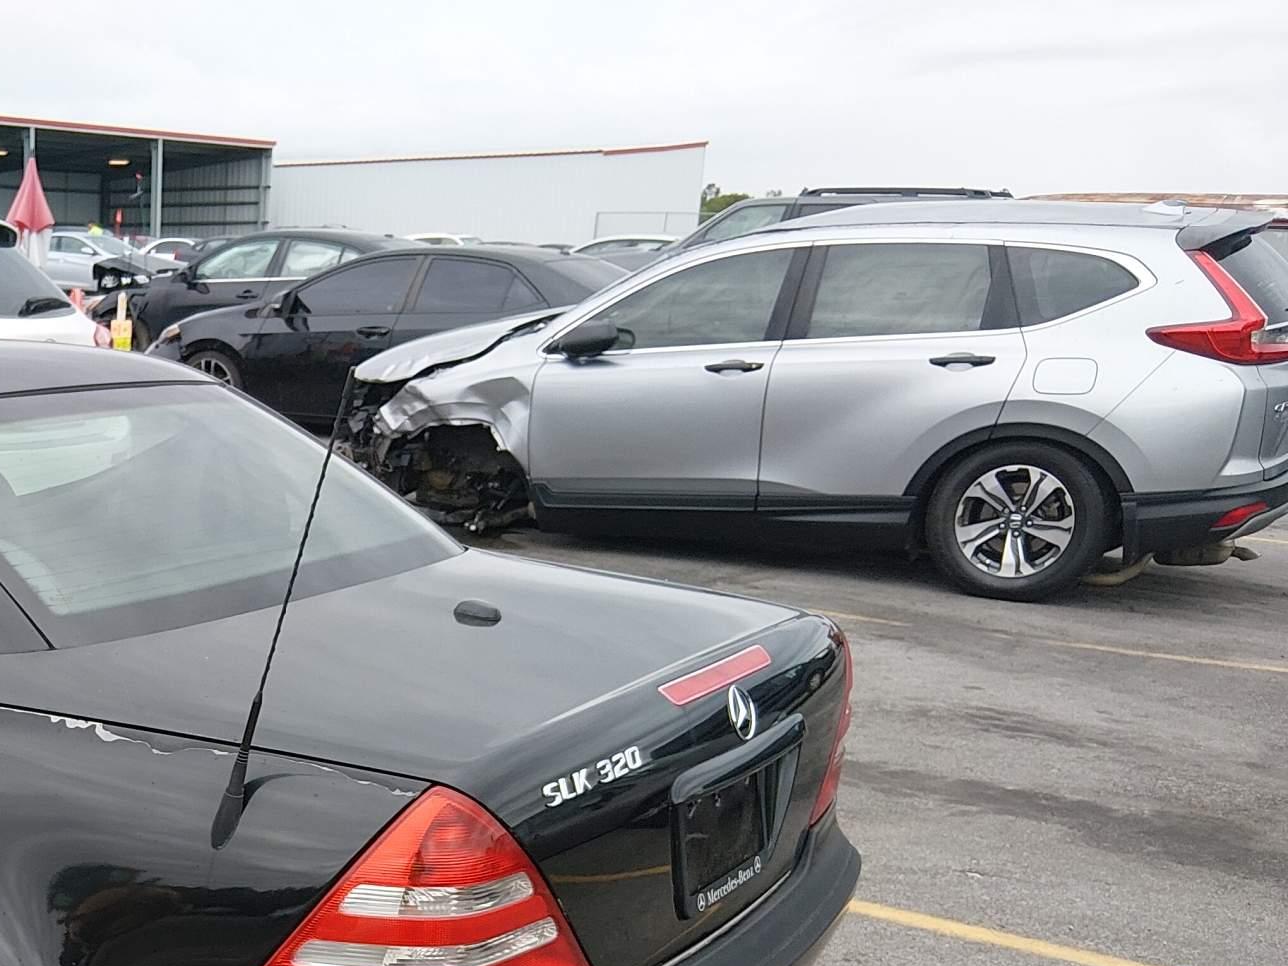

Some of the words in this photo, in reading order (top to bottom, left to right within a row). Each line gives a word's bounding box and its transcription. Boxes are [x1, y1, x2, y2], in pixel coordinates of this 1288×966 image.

[542, 768, 592, 807] SLK
[596, 745, 642, 783] 320
[706, 866, 754, 906] Mercedes-Benz
